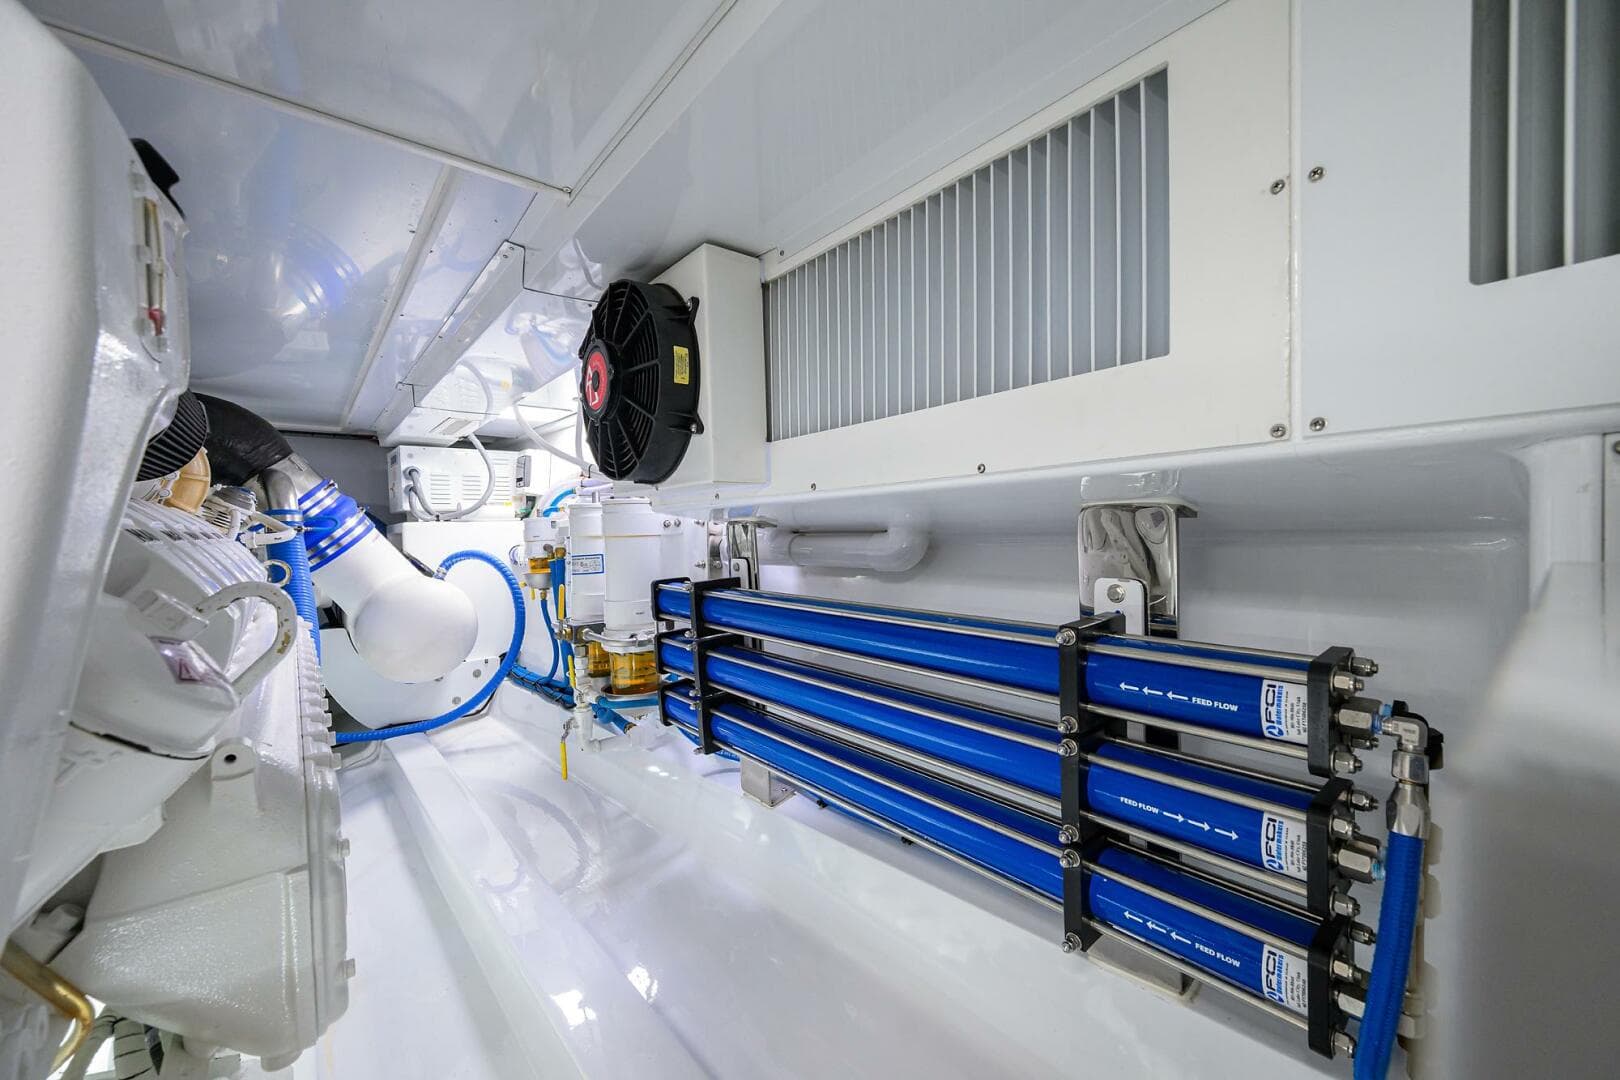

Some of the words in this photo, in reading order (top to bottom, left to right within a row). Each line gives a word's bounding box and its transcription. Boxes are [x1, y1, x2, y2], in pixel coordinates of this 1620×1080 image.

[1192, 697, 1212, 707] FEED
[1214, 701, 1239, 712] FLOW
[1265, 684, 1276, 724] FCI
[1120, 796, 1138, 807] FEED
[1138, 802, 1159, 814] FLOW
[1265, 817, 1277, 859] FCI
[1195, 942, 1215, 956] FEED
[1216, 952, 1240, 968] FLOW
[1266, 950, 1277, 991] FCI
